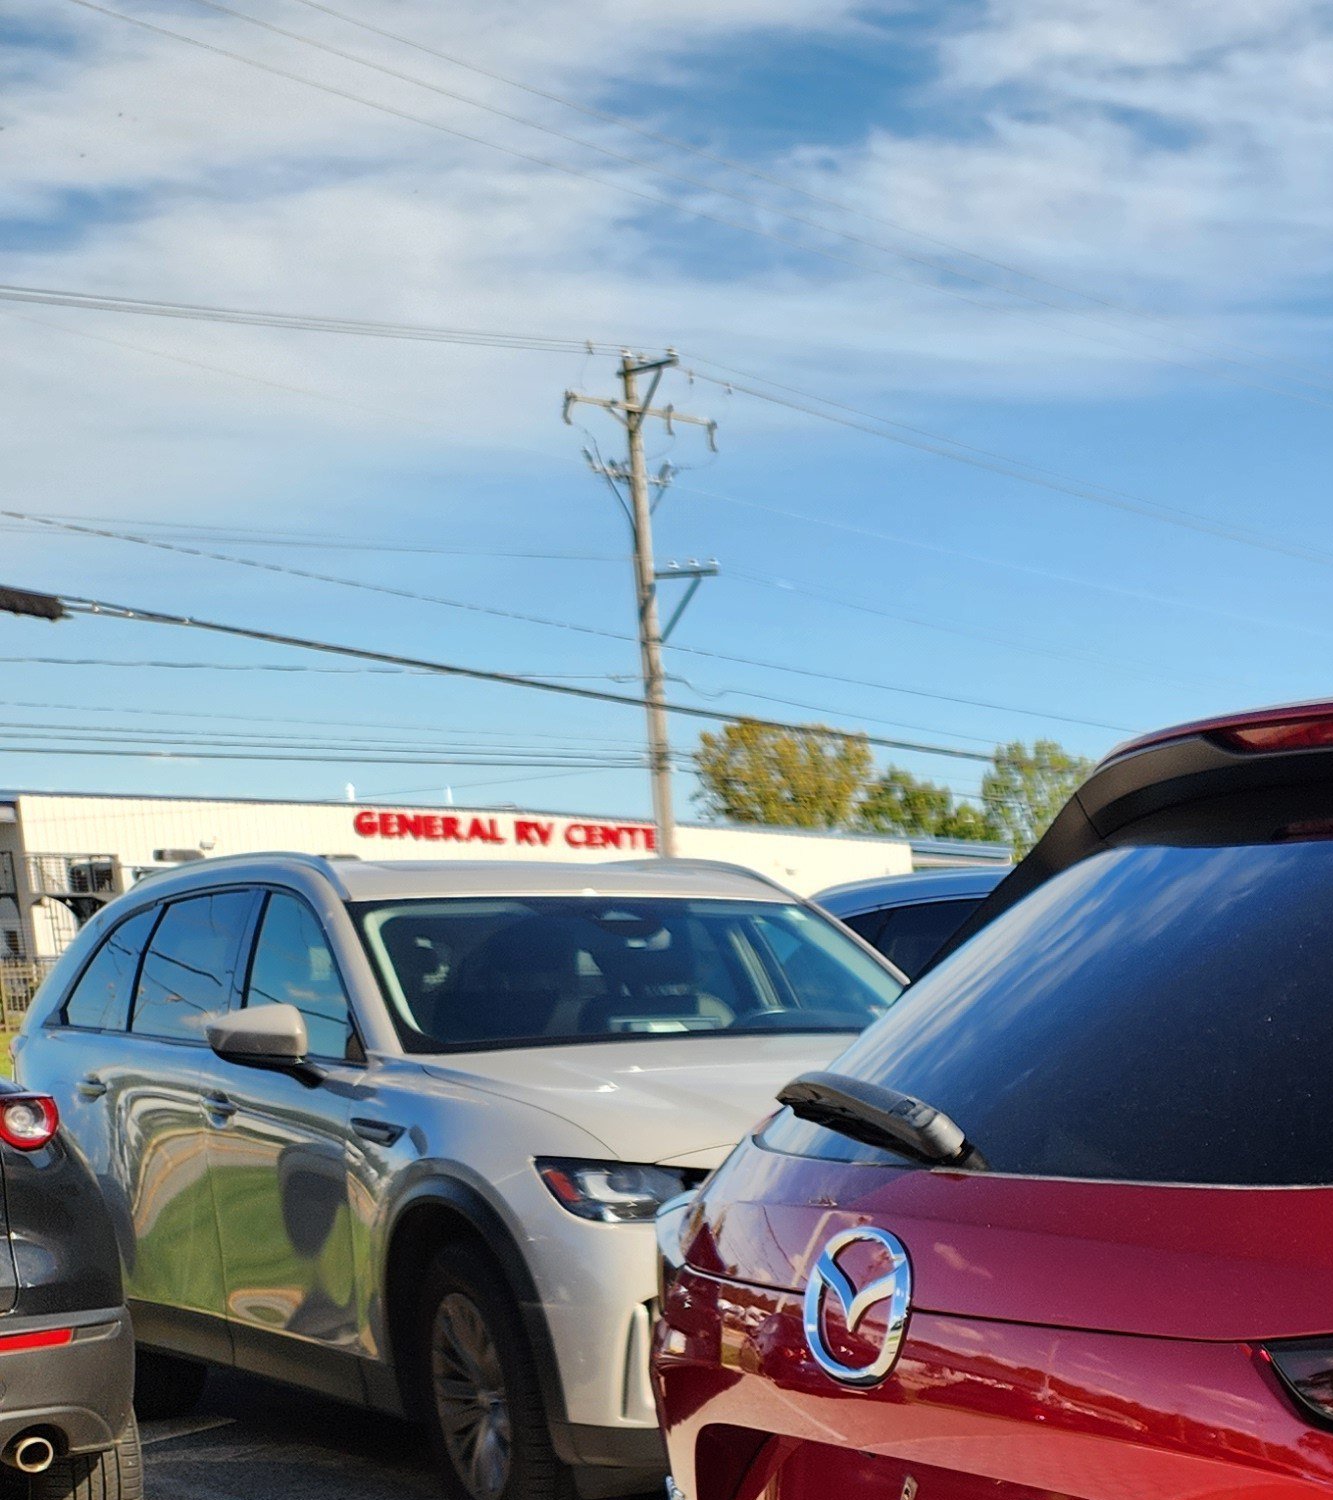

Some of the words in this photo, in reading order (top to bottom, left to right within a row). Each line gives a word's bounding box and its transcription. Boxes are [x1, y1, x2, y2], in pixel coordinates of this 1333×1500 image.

[354, 811, 507, 844] GENERAL
[513, 819, 554, 846] RV
[564, 824, 657, 851] CENTE
